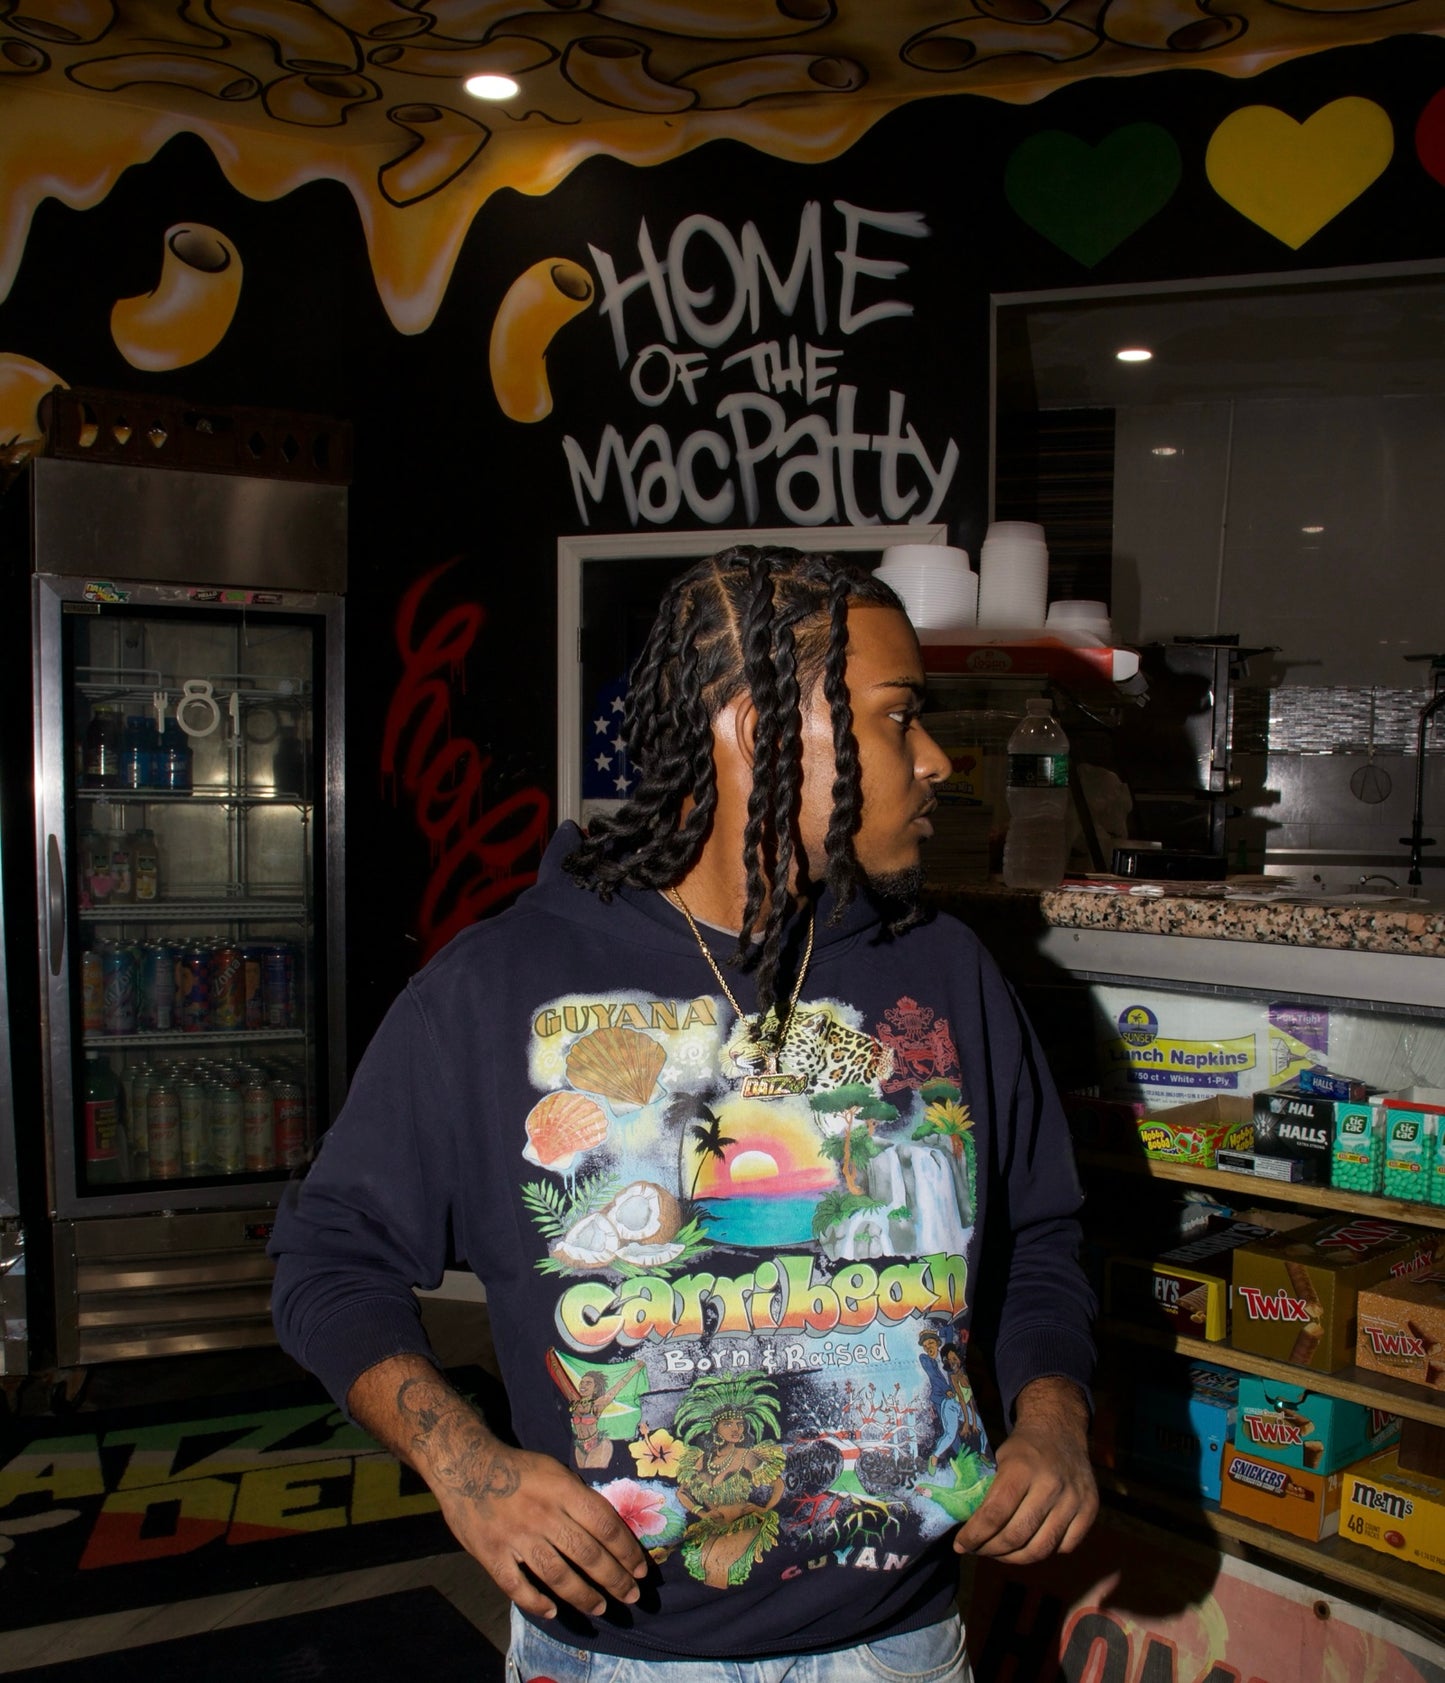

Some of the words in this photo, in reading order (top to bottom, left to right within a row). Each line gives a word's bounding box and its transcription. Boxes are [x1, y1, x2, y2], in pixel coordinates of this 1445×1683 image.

[587, 200, 932, 370] HOME
[630, 344, 708, 407] OF
[721, 335, 844, 406] THE
[534, 998, 718, 1038] GUYANA
[1122, 1031, 1156, 1043] SUNSET
[1170, 1049, 1248, 1068] Napkins
[1151, 1073, 1159, 1081] ct
[1169, 1074, 1195, 1084] White
[1207, 1076, 1230, 1086] 1-Ply
[1312, 1077, 1334, 1090] HALLS
[1345, 1123, 1362, 1132] tac
[1350, 1116, 1364, 1126] tic
[1400, 1123, 1416, 1133] tic
[1396, 1130, 1414, 1140] tac
[1389, 1250, 1433, 1279] Twix
[1238, 1286, 1310, 1324] Twix
[663, 1349, 750, 1374] Born
[785, 1333, 890, 1370] Raised
[1364, 1327, 1426, 1358] Twix
[1243, 1414, 1304, 1445] Twix
[1231, 1459, 1285, 1488] SNICKERS
[1347, 1514, 1364, 1535] 48
